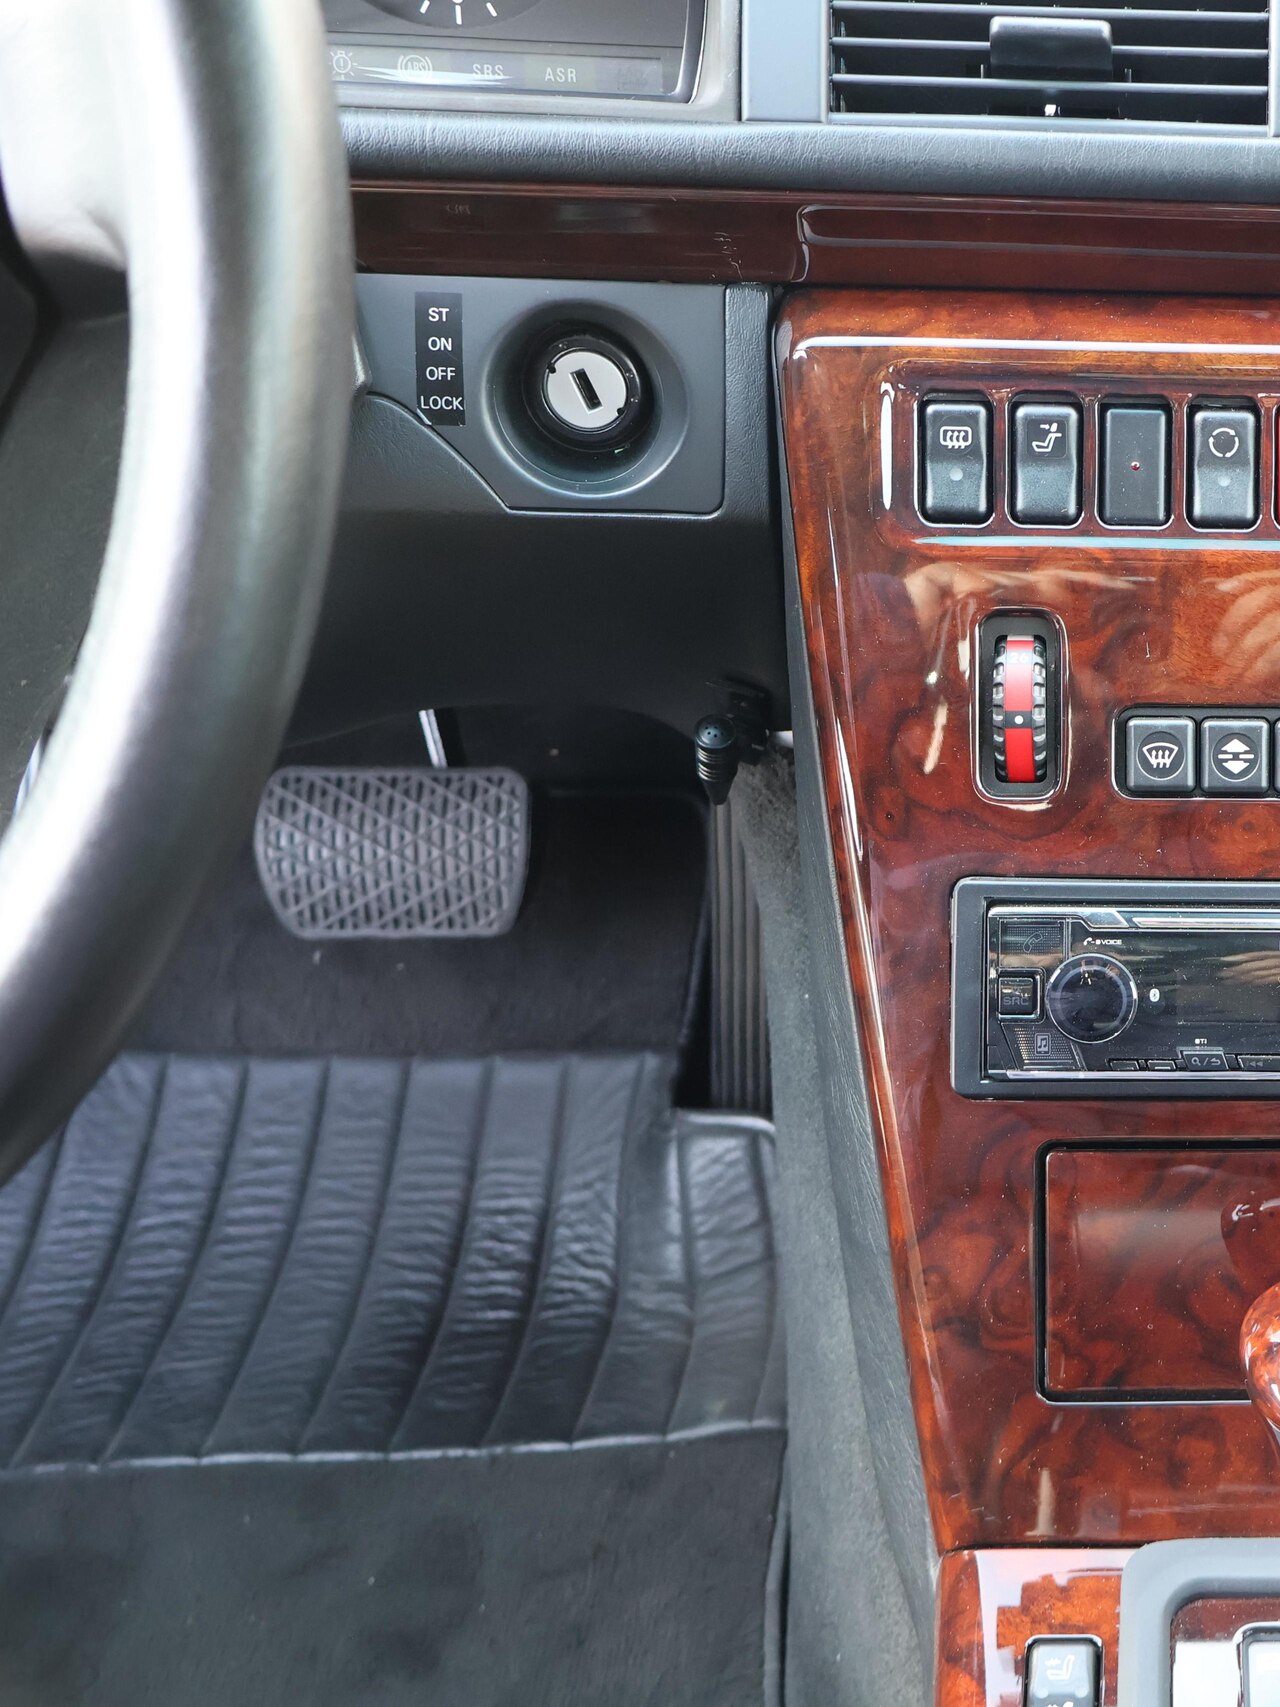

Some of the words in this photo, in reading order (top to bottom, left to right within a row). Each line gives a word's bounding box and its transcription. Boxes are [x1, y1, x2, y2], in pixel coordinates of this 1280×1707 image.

[472, 63, 504, 78] SRS
[544, 67, 577, 83] ASR
[428, 307, 449, 322] ST
[428, 337, 452, 351] ON
[426, 367, 456, 381] OFF
[420, 395, 463, 410] LOCK
[1009, 652, 1029, 664] 26
[1002, 996, 1029, 1006] SRC
